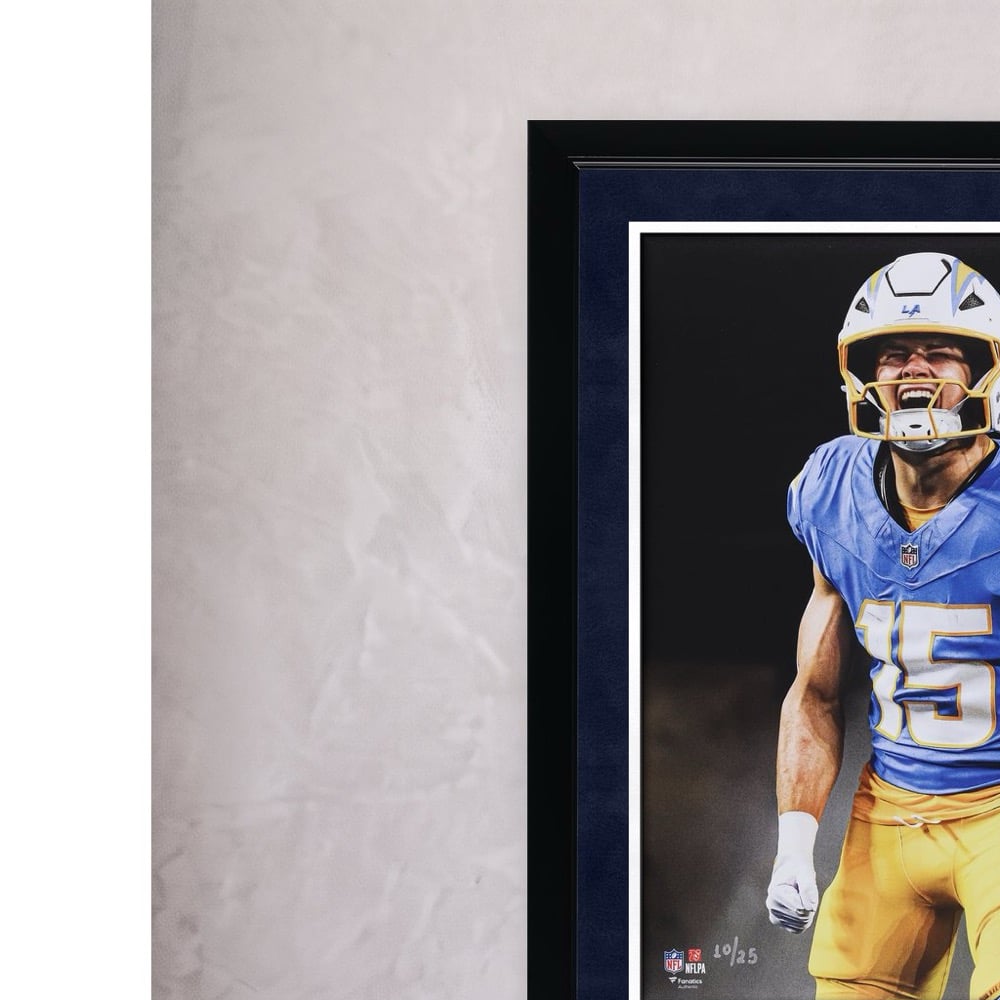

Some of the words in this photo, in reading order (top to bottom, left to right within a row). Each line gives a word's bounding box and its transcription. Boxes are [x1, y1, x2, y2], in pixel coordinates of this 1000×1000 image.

[901, 304, 921, 318] LA
[855, 598, 998, 749] 15
[713, 935, 759, 968] 10/25
[685, 962, 706, 974] NFLPA
